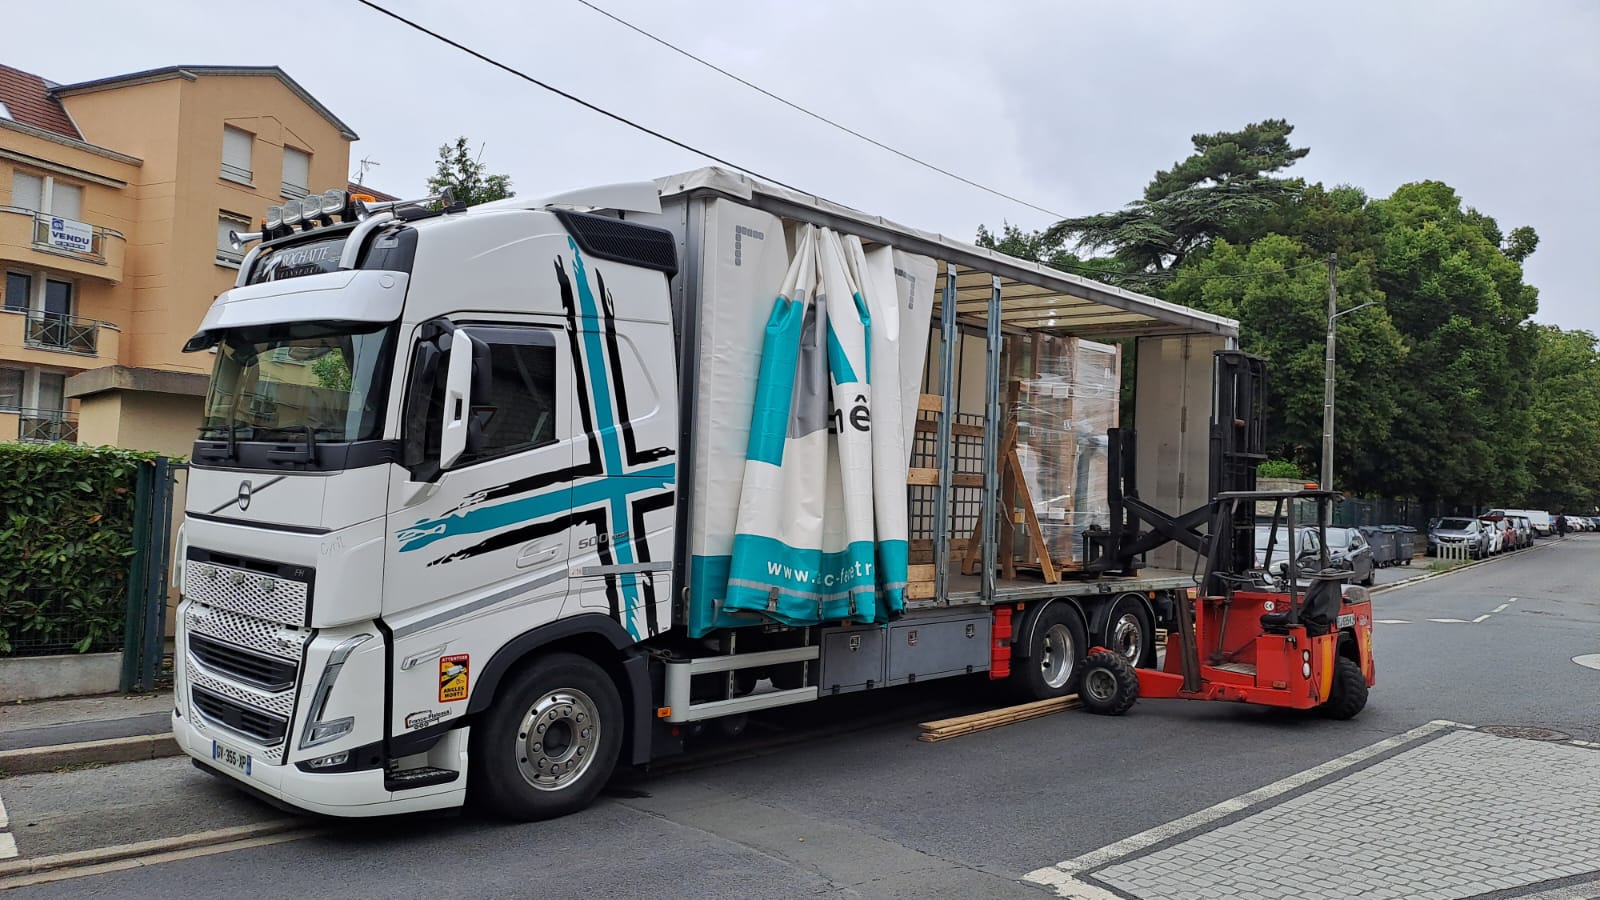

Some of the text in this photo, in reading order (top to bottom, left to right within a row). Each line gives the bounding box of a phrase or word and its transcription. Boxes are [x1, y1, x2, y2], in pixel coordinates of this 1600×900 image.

[52, 231, 89, 245] VENDU
[578, 533, 608, 549] 500
[295, 569, 304, 577] FH
